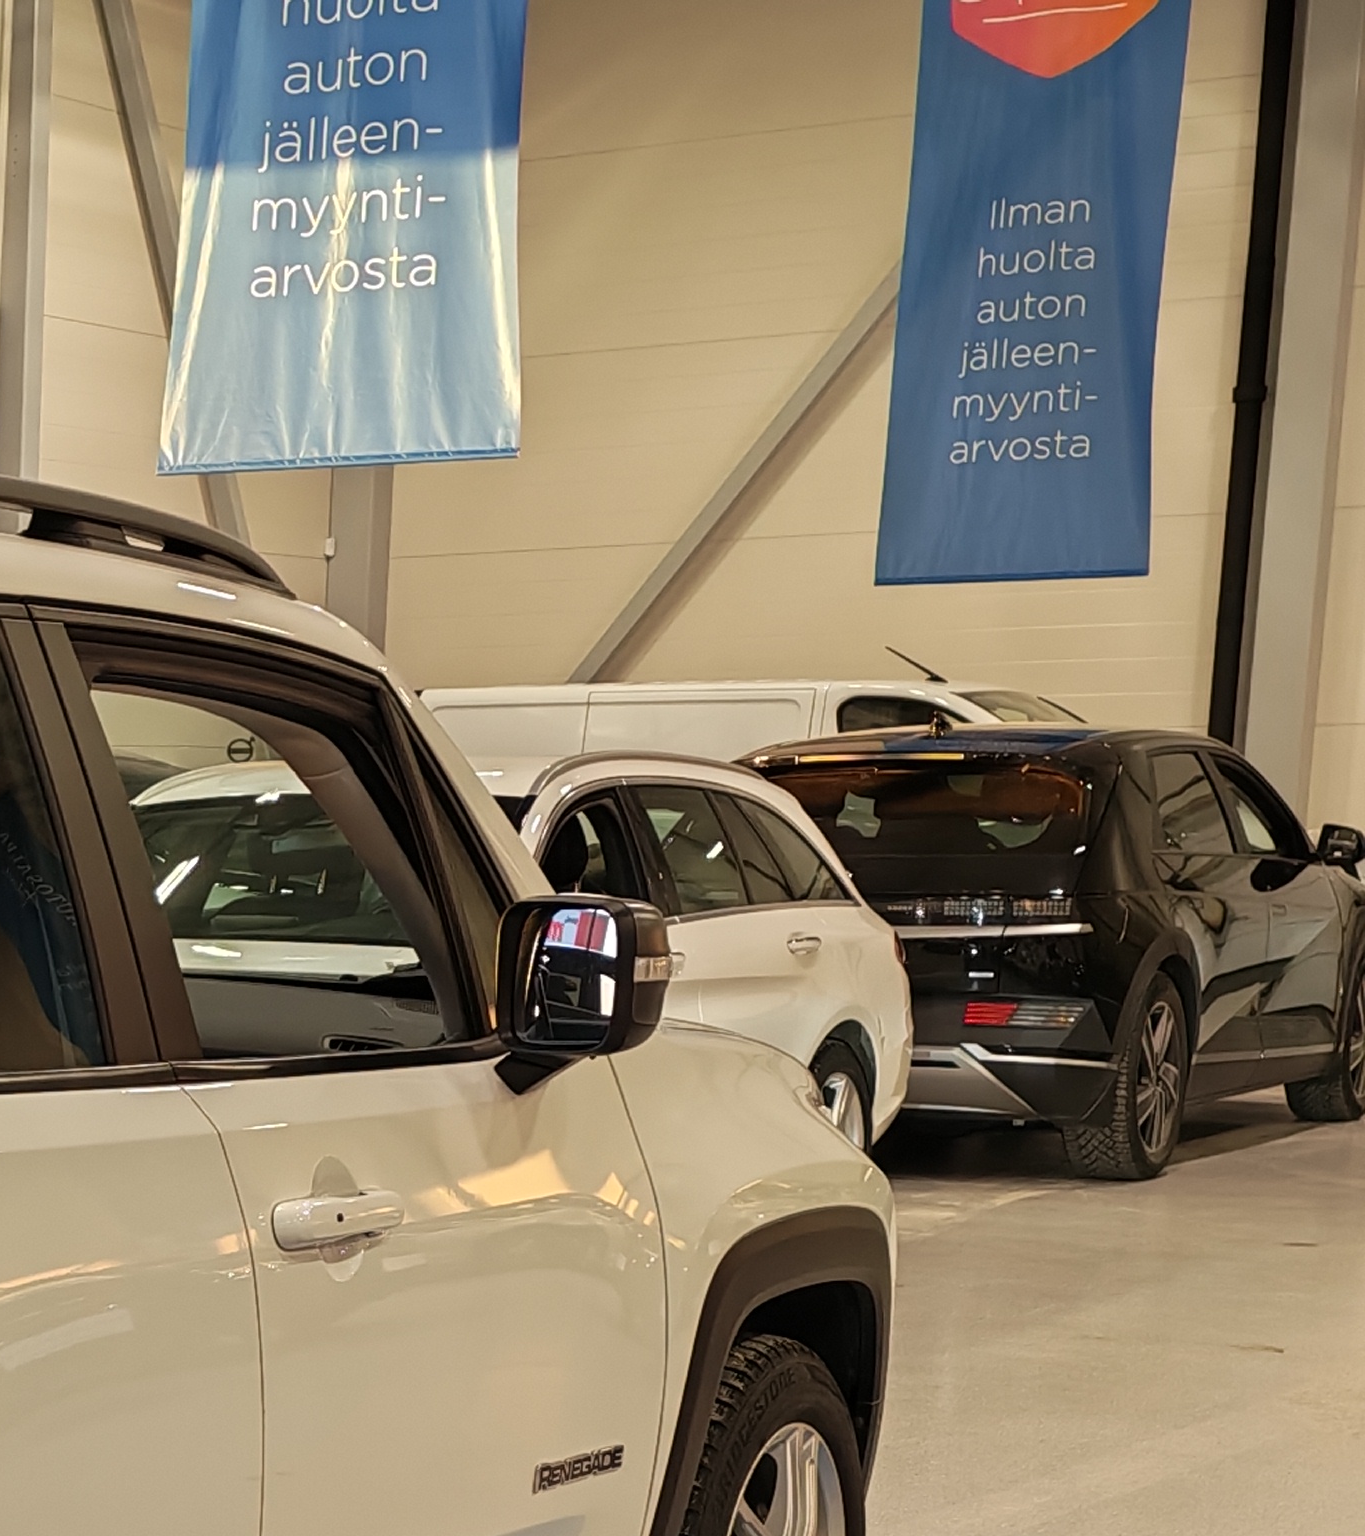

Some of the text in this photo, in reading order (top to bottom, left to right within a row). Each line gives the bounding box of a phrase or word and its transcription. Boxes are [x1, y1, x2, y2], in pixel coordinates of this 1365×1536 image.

[283, 47, 428, 95] auton
[257, 115, 443, 173] jälleen-
[252, 174, 446, 238] myynti-
[989, 197, 1091, 231] Ilman
[250, 246, 437, 298] arvosta
[977, 240, 1096, 278] huolta
[976, 291, 1086, 325] auton
[957, 338, 1097, 379] jälleen-
[952, 381, 1099, 422] myynti-
[949, 430, 1091, 465] arvosta
[533, 1444, 624, 1494] RENEGADE
